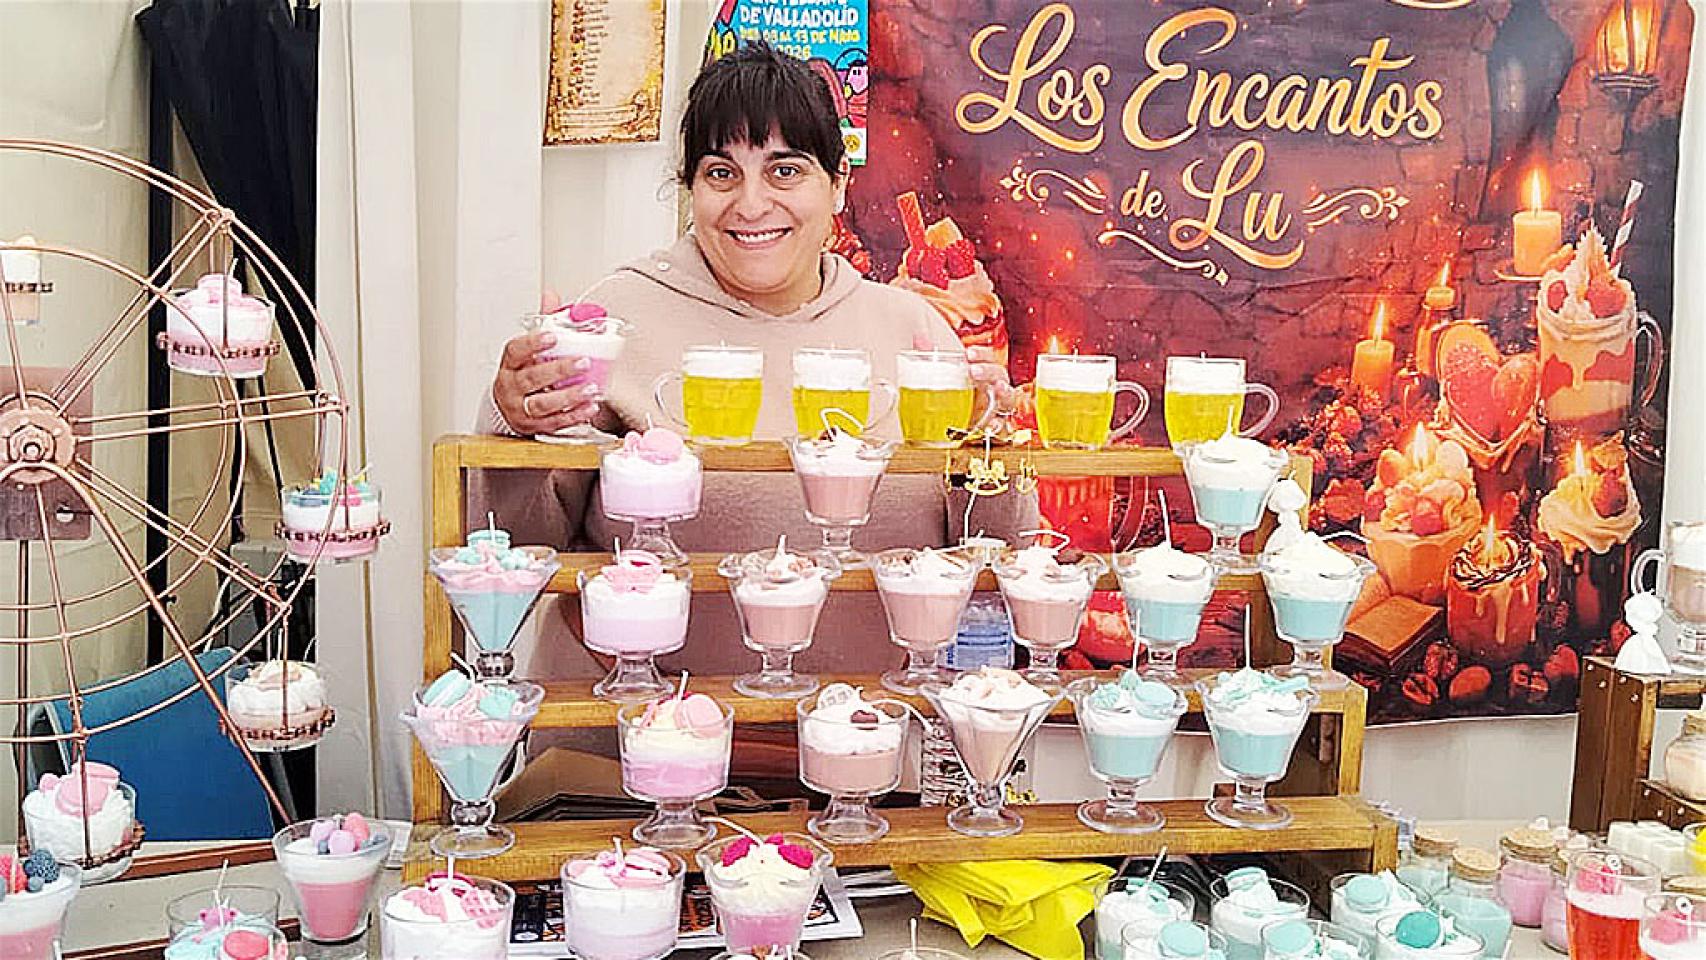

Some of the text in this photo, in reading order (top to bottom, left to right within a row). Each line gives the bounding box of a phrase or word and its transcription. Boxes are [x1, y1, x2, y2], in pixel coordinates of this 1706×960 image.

[740, 5, 760, 23] DE
[810, 29, 827, 44] DE
[955, 2, 1445, 154] Los Encantos
[1120, 139, 1304, 269] de Lu
